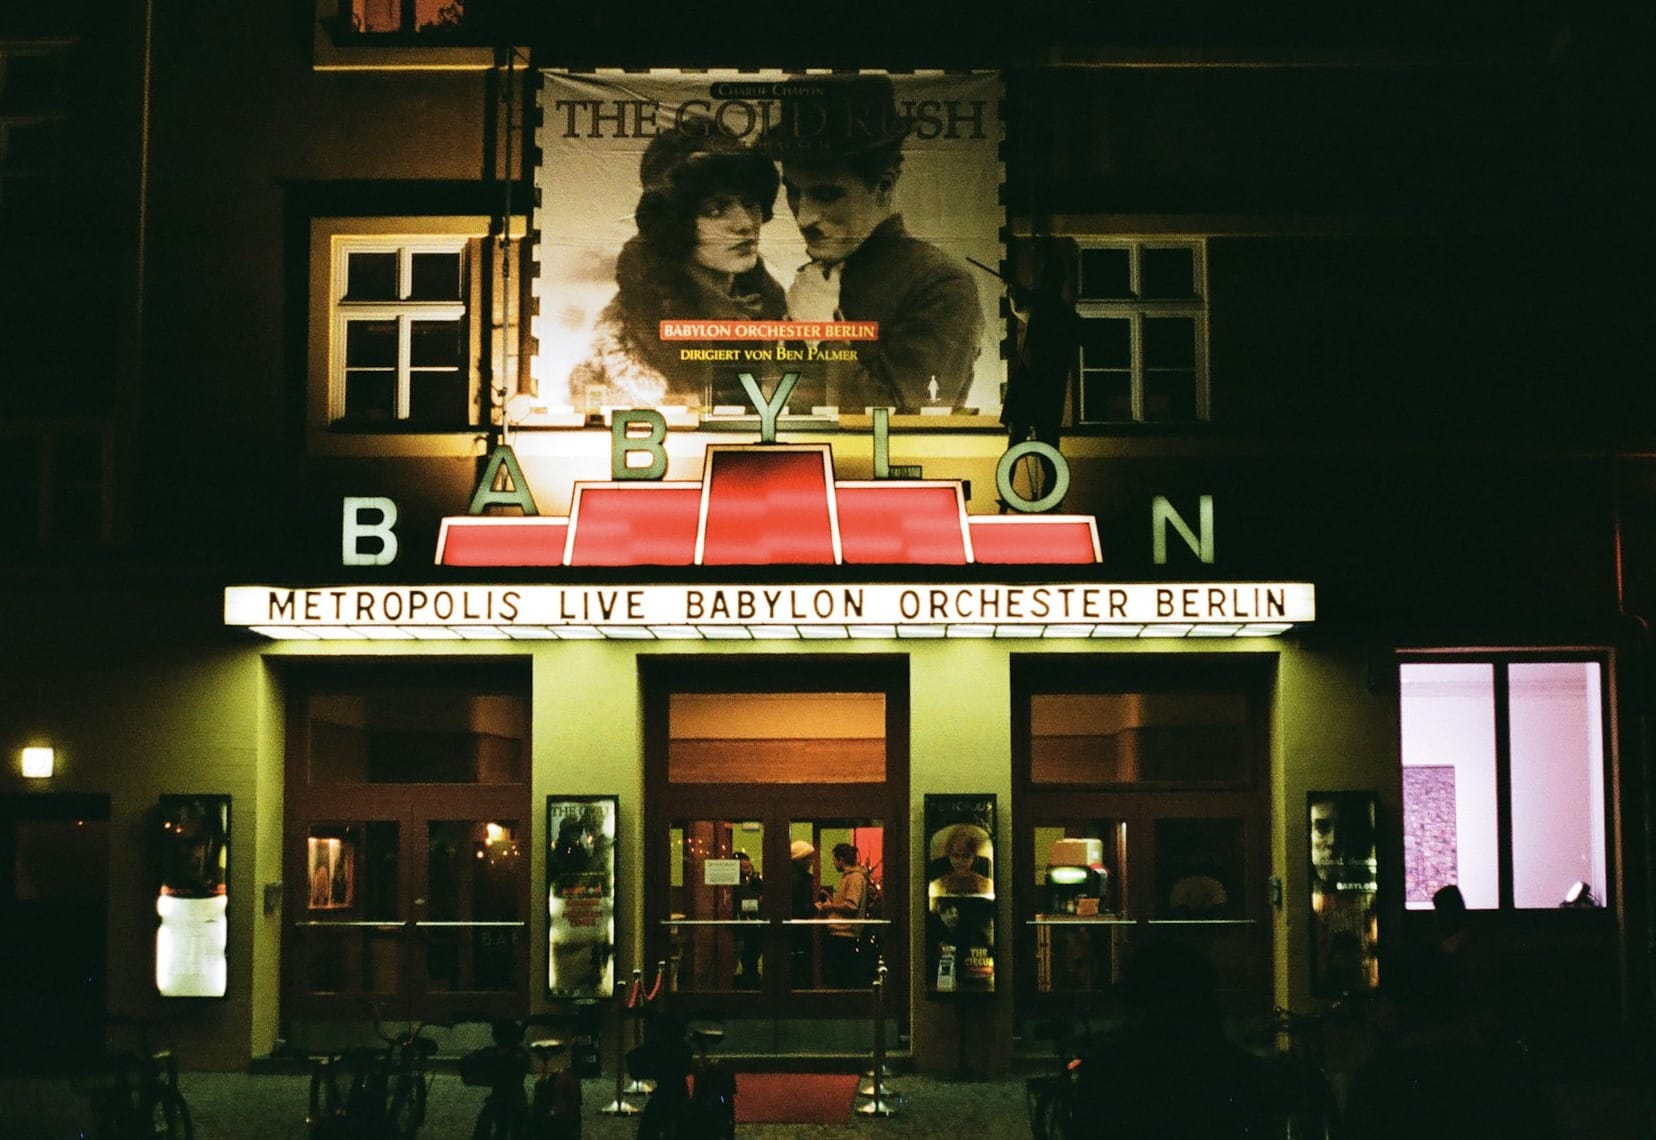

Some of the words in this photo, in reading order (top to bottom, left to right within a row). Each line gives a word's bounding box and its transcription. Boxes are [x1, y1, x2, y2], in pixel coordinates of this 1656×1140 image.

[557, 100, 660, 139] THE
[848, 99, 987, 139] RUSH
[664, 324, 732, 337] BABYLON
[735, 324, 821, 338] ORCHESTER
[825, 324, 875, 338] BERLIN
[342, 371, 1216, 567] BABYLON
[269, 590, 521, 621] METROPOLIS
[560, 591, 645, 620] LIVE
[686, 589, 864, 619] BABYLON
[901, 588, 1127, 618] ORCHESTER
[1157, 588, 1285, 617] BERLIN
